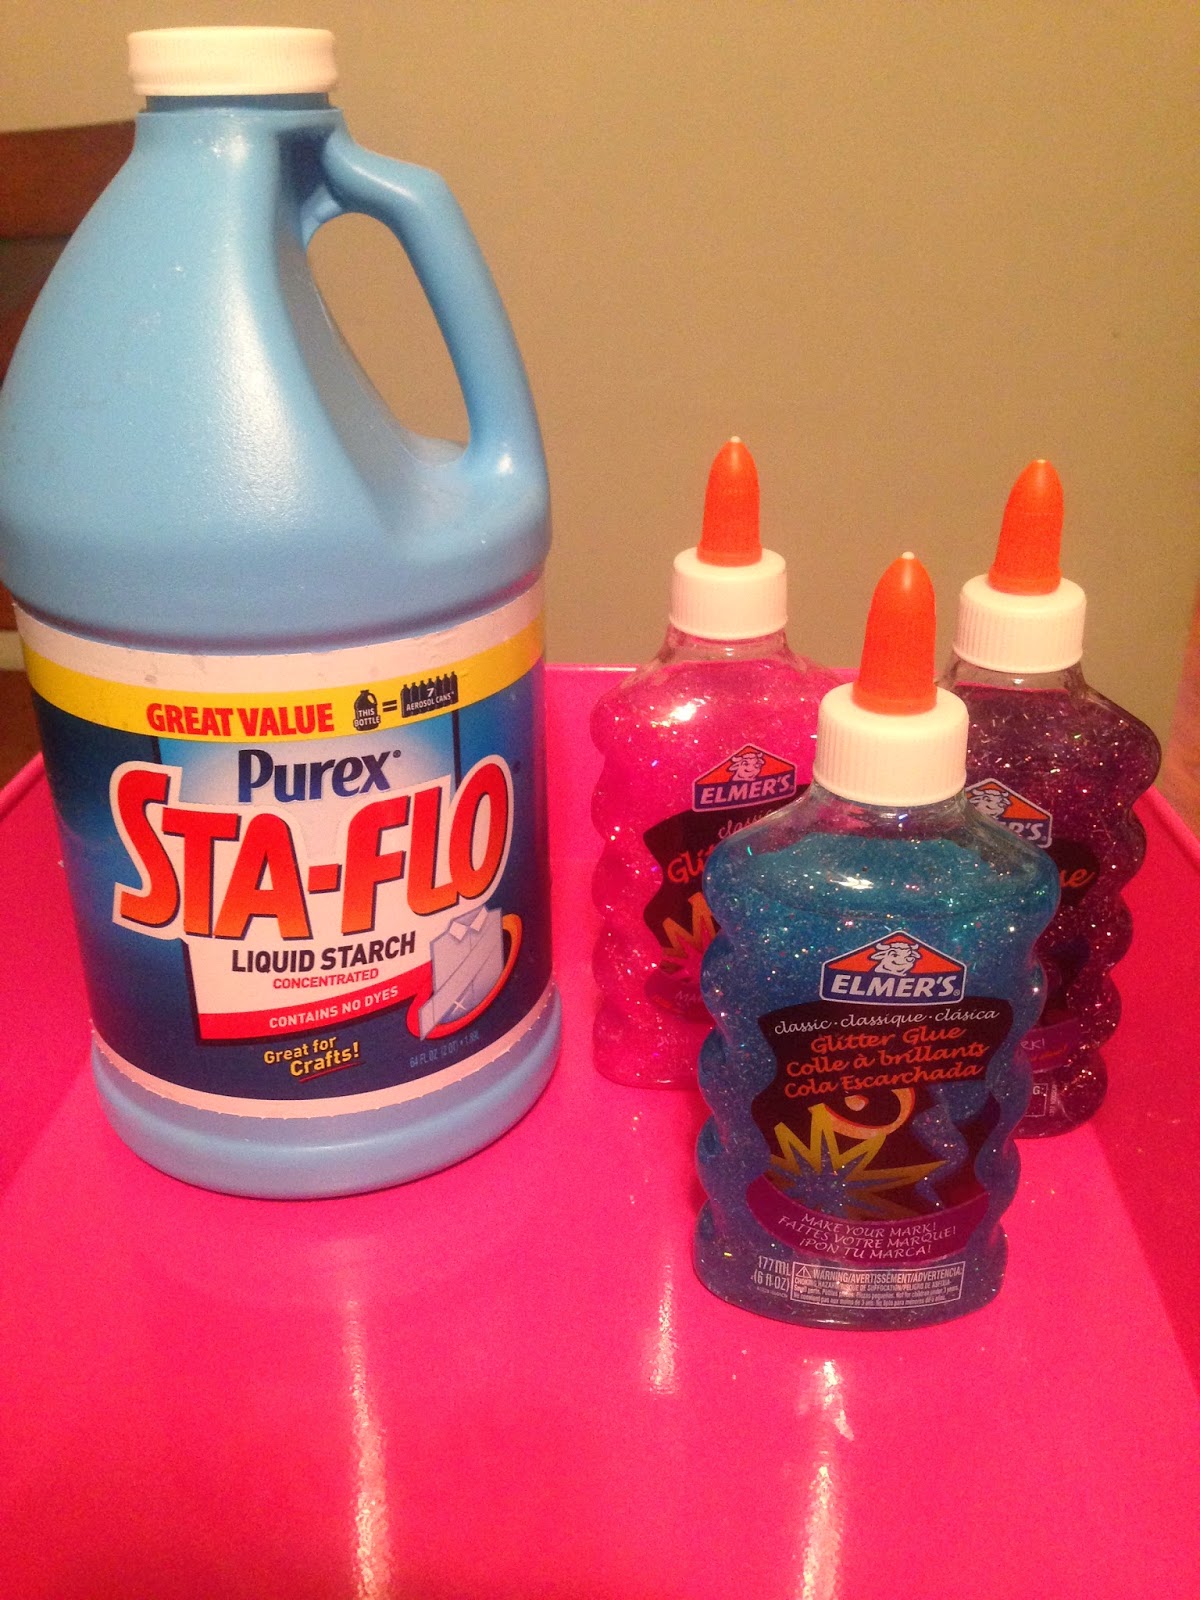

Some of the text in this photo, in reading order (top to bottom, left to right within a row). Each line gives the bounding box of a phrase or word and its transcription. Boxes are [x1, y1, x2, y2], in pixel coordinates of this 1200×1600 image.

[406, 698, 435, 711] AEROSOL
[426, 687, 434, 697] 7
[146, 702, 335, 737] GREAT VALUE
[354, 716, 380, 727] BOTTLE
[358, 707, 375, 717] THIS
[700, 773, 791, 806] ELMER'S
[117, 762, 511, 940] STA-FLO
[231, 931, 416, 974] LIQUID STARCH
[272, 968, 379, 989] CONCENTRATED
[830, 973, 957, 998] ELMER'S
[269, 985, 399, 1029] CONTAINS NO DYES
[774, 1018, 832, 1035] classic
[839, 1010, 926, 1029] classique
[264, 1036, 337, 1064] Great for
[810, 1025, 967, 1055] Glitter Glue
[290, 1041, 360, 1077] Crafts!
[785, 1042, 990, 1078] Colle à brillants
[784, 1061, 985, 1099] Cola Escarchada
[777, 1215, 957, 1249] FAITES VOTRE MARQUE!
[801, 1213, 937, 1238] MAKE YOUR MARK!
[843, 1246, 865, 1259] TU
[869, 1244, 932, 1260] MARCA!
